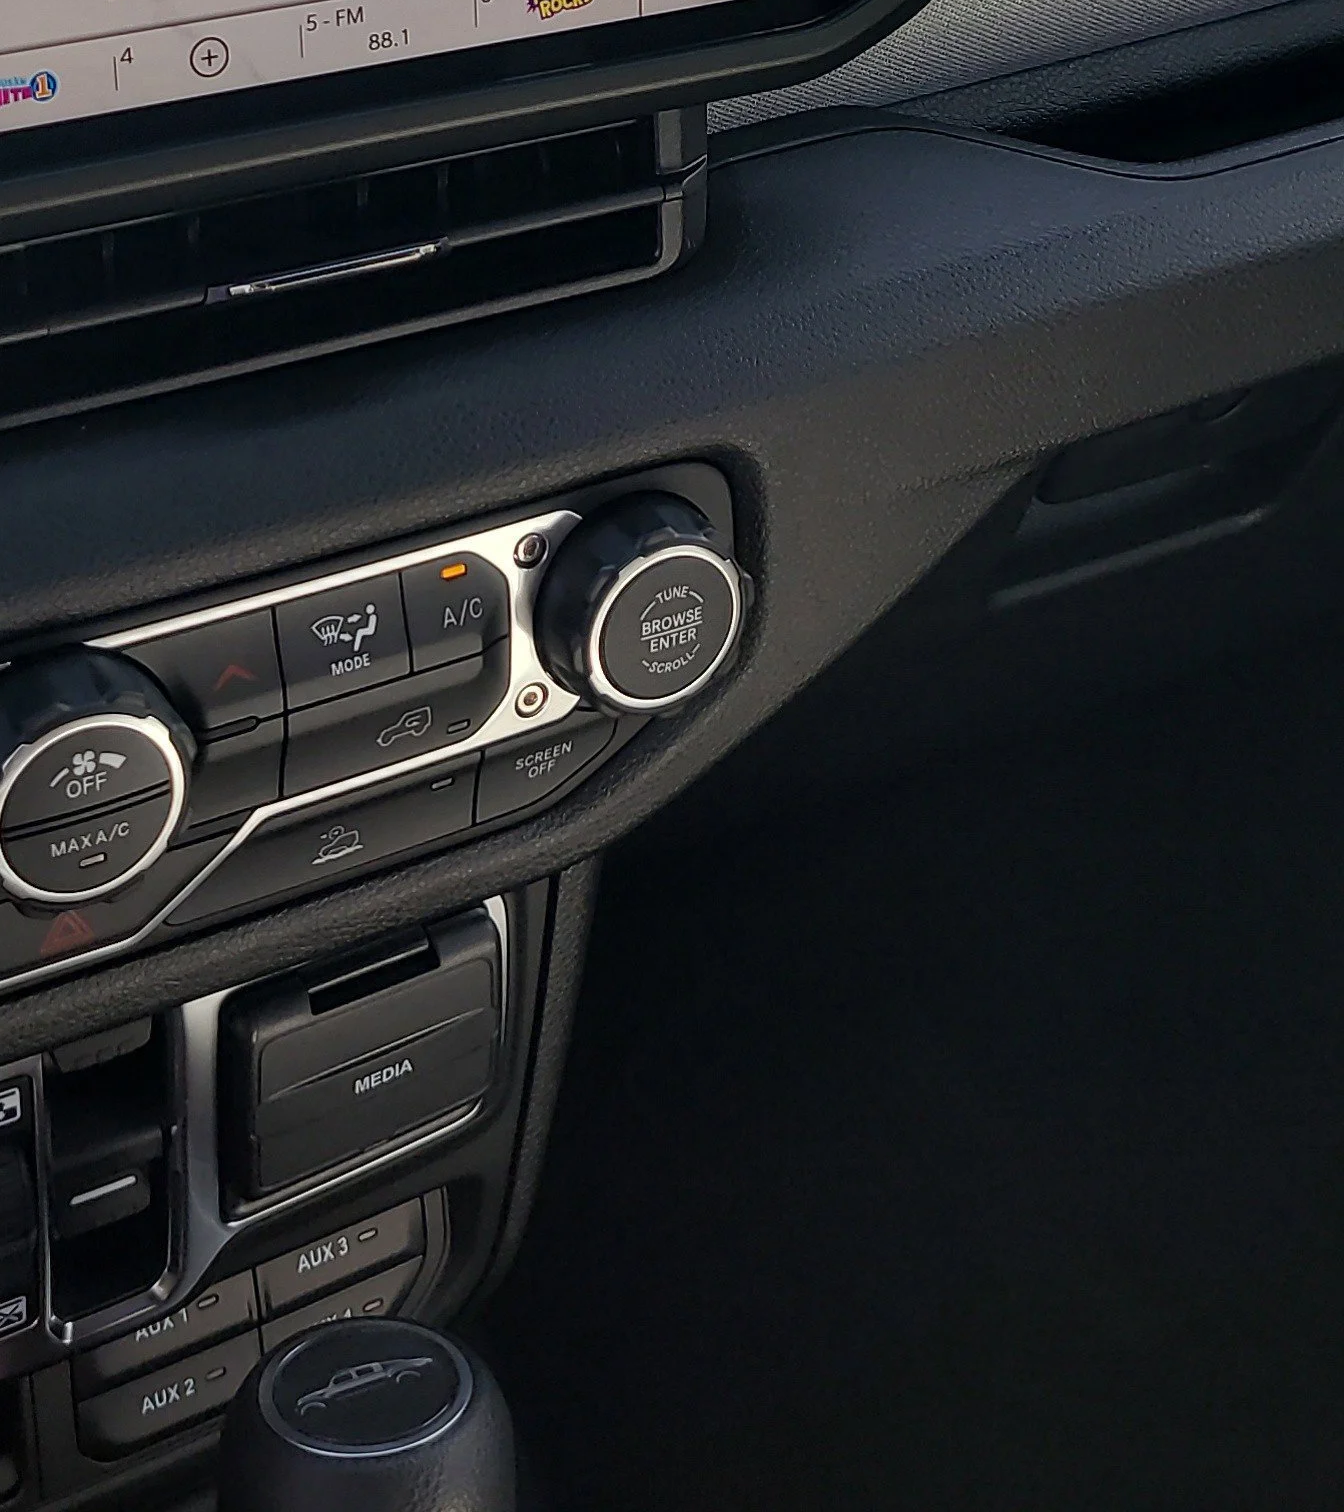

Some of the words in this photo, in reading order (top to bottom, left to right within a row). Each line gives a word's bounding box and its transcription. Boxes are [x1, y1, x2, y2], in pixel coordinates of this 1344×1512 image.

[307, 14, 318, 31] 5
[335, 6, 365, 29] FM
[368, 29, 410, 52] 88.1
[120, 48, 134, 65] 4
[655, 585, 690, 604] TUNE
[443, 597, 484, 629] A/C
[642, 606, 702, 636] BROWSE
[650, 628, 697, 653] ENTER
[330, 653, 371, 676] MODE
[648, 652, 695, 674] SCROLL
[515, 740, 573, 771] SCREEN
[528, 761, 557, 779] OFF
[66, 771, 108, 798] OFF
[51, 833, 93, 857] MAX
[95, 822, 130, 845] A/C
[355, 1059, 413, 1094] MEDIA
[296, 1248, 335, 1274] AUX
[338, 1236, 349, 1256] 3
[141, 1388, 181, 1416] AUX
[183, 1377, 197, 1398] 2
